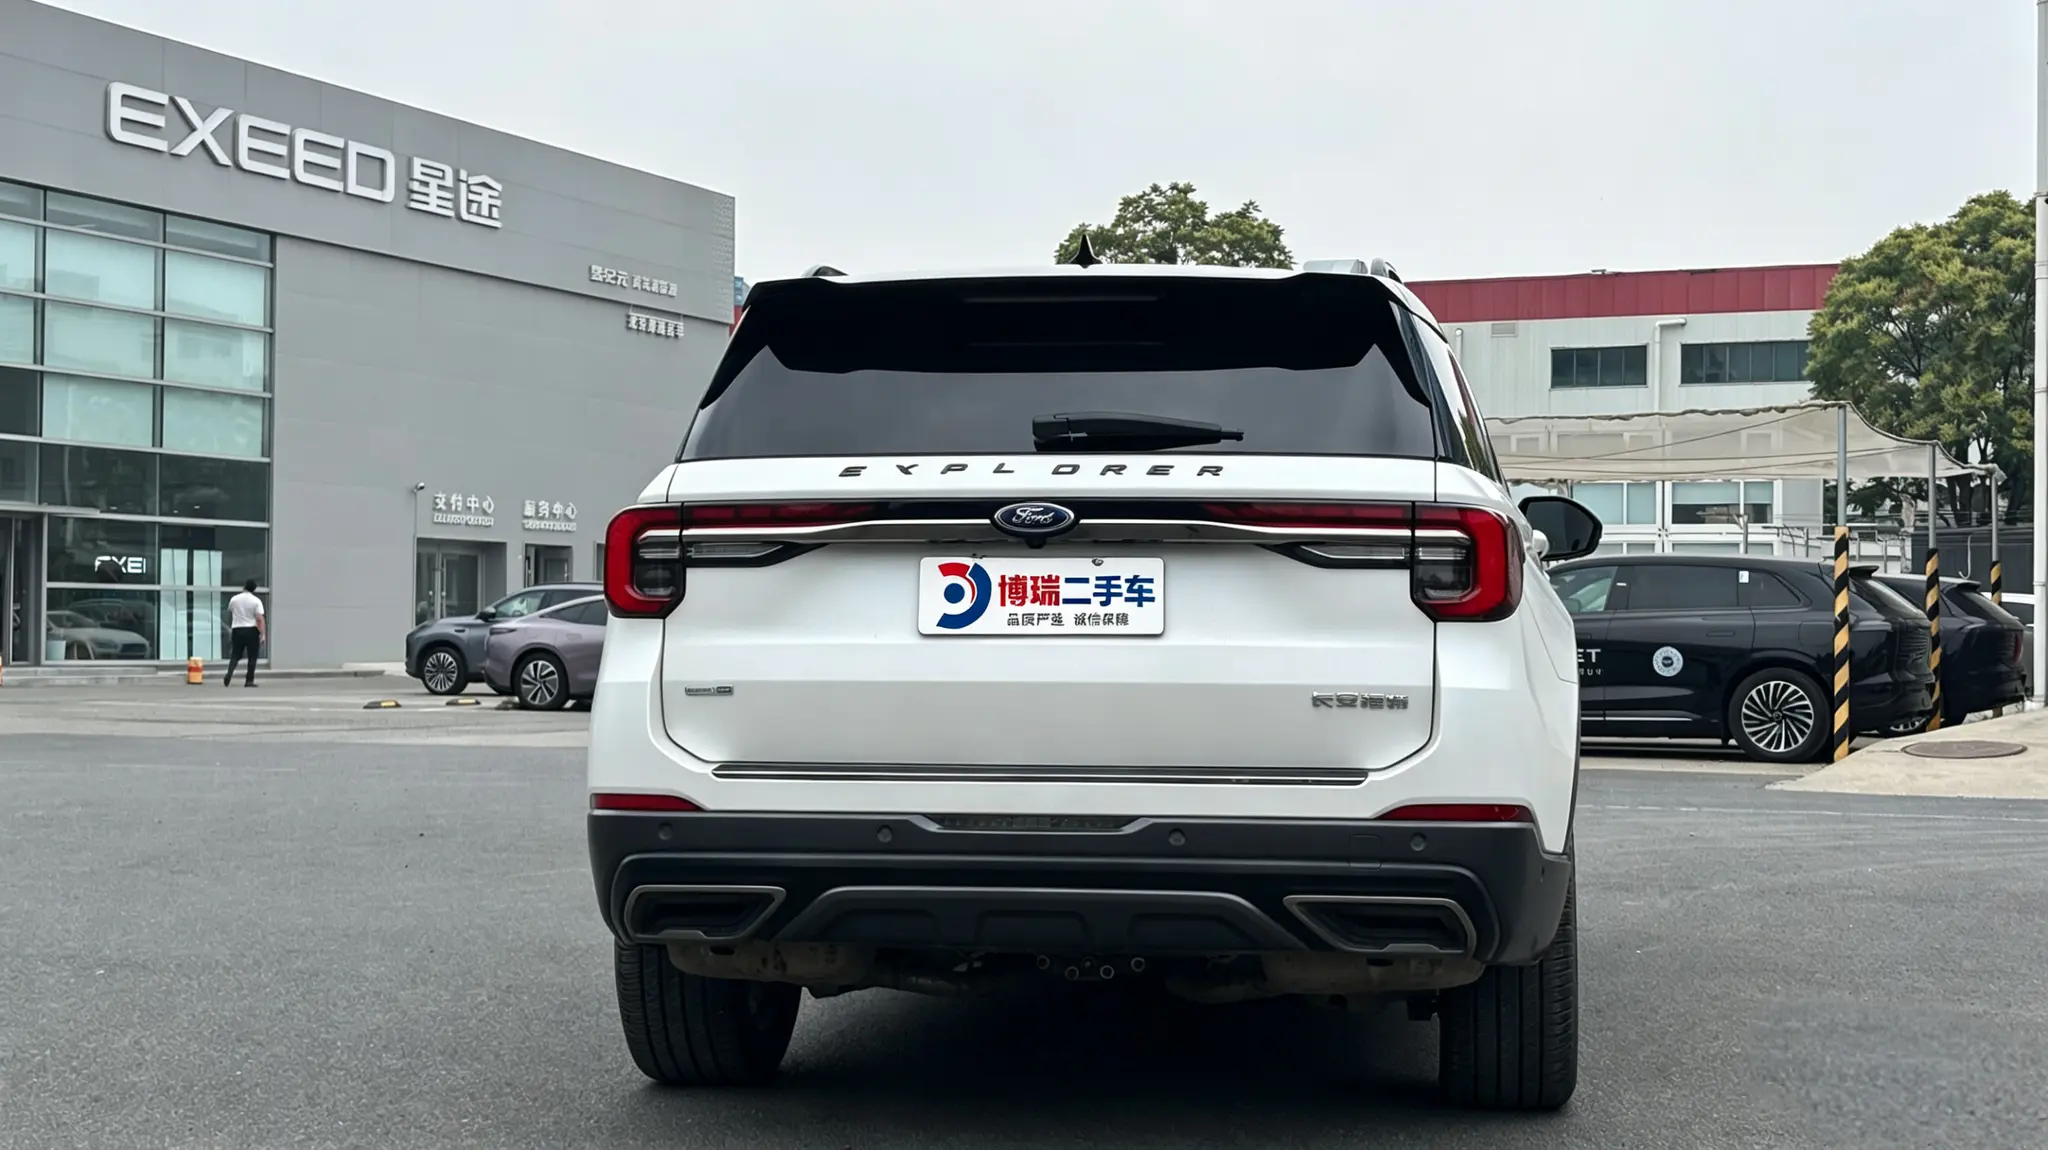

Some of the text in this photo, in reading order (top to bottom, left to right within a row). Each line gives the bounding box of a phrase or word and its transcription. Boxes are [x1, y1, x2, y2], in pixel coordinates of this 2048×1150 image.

[106, 81, 503, 229] EXEED 星途
[1012, 506, 1055, 525] Ford
[998, 574, 1156, 608] 博瑞二手车
